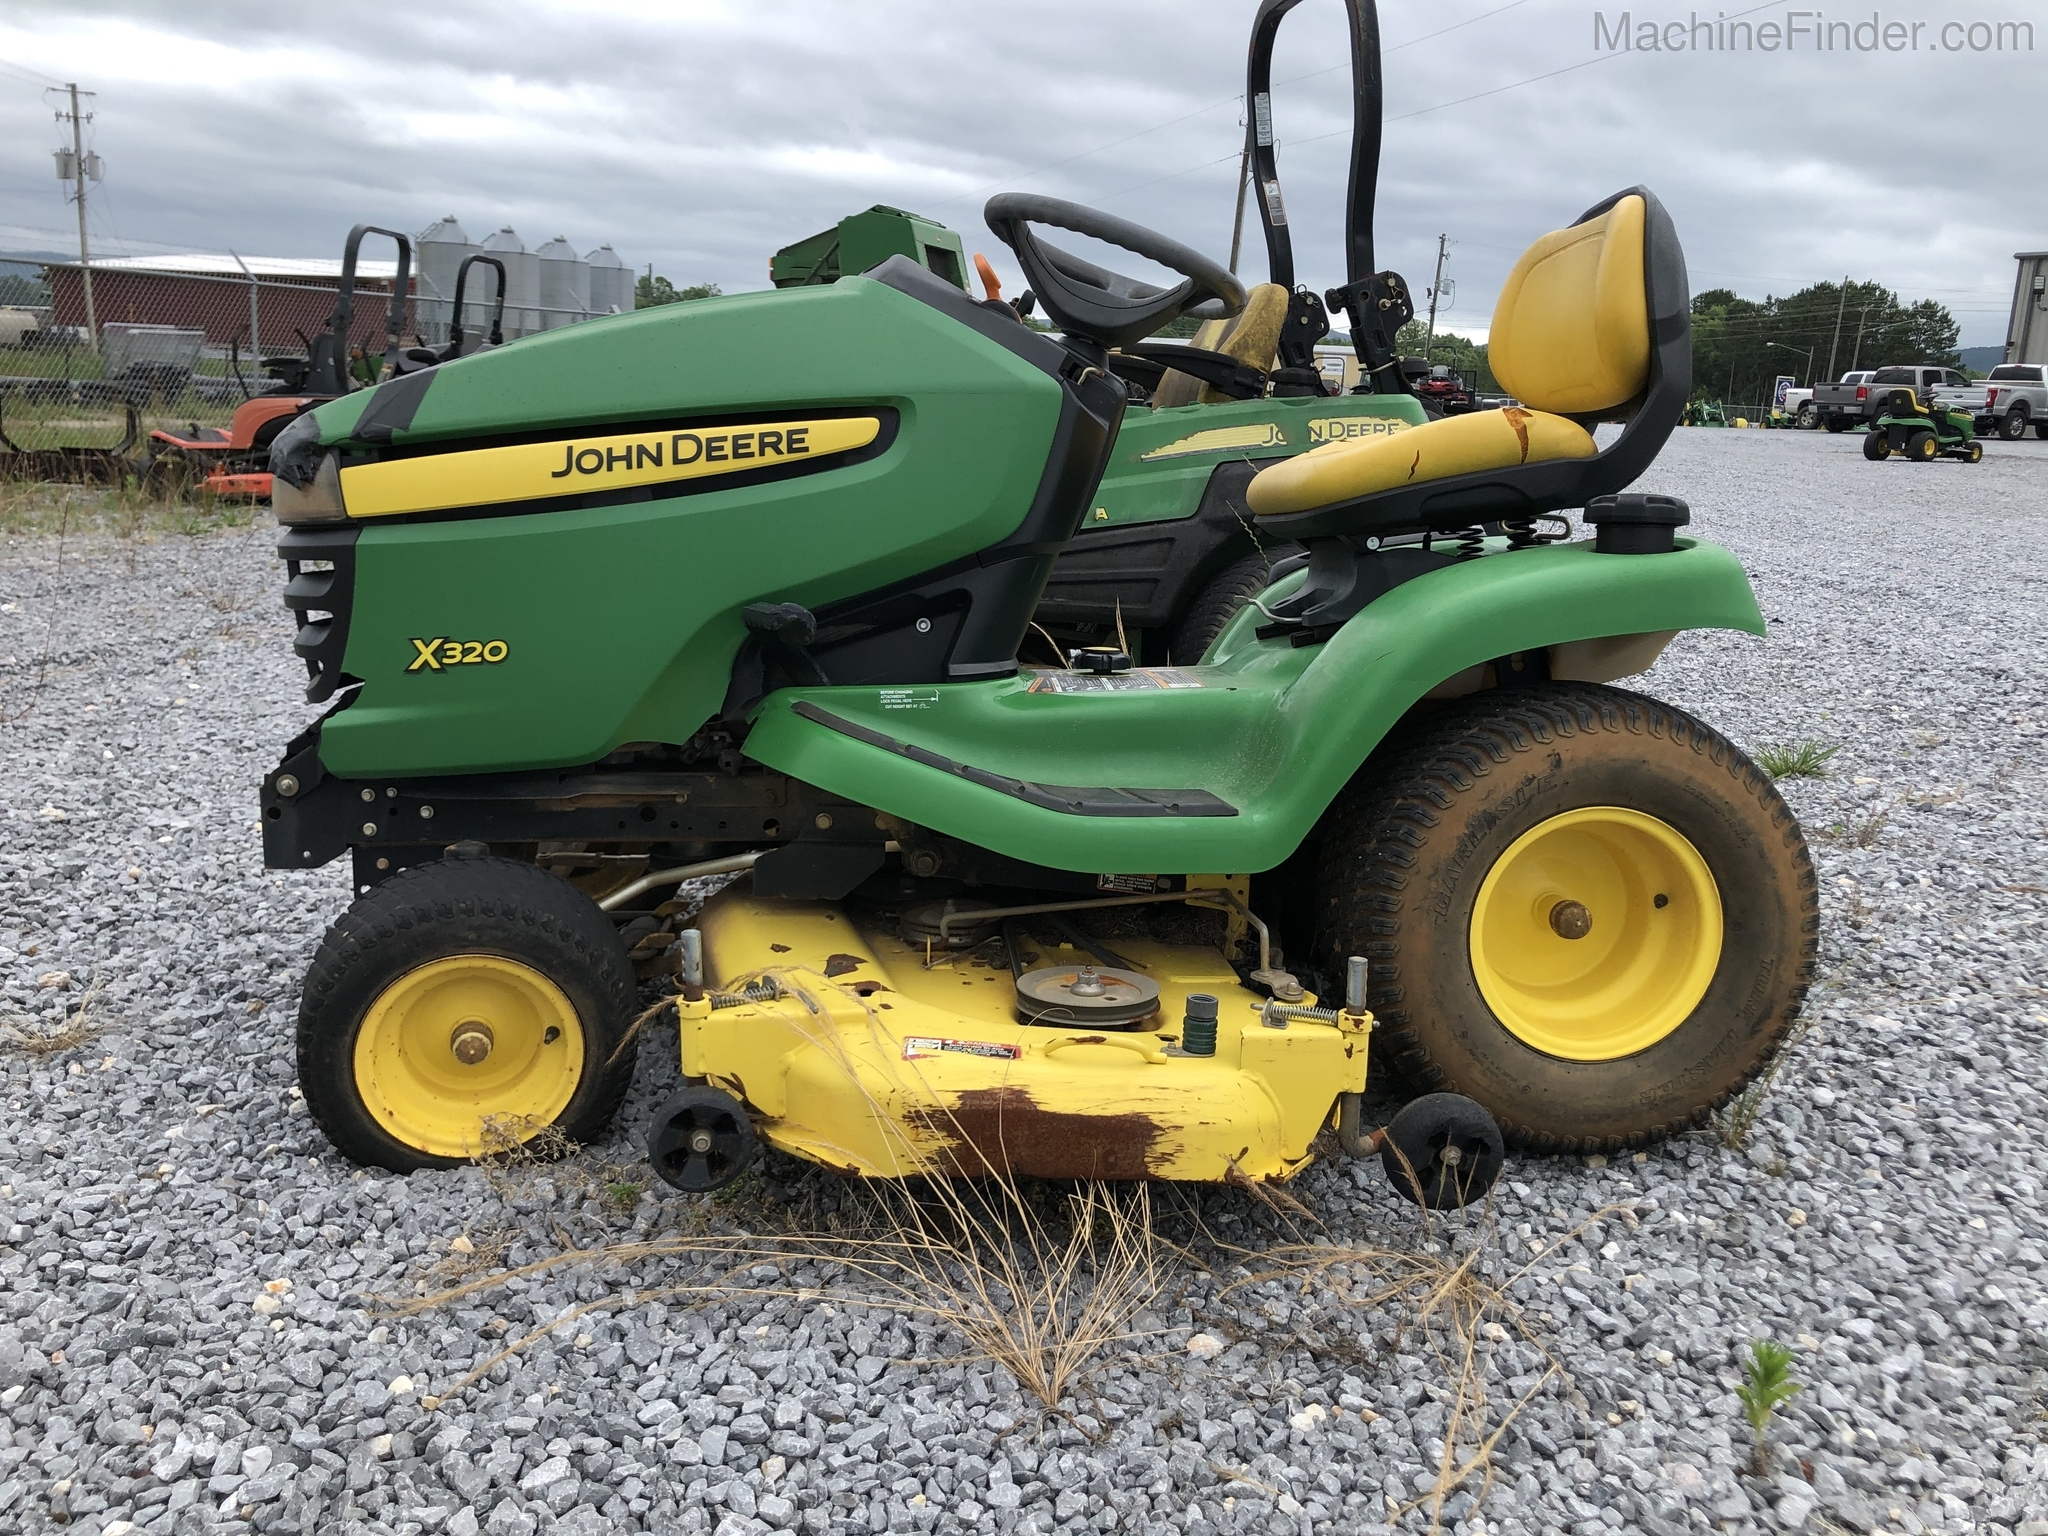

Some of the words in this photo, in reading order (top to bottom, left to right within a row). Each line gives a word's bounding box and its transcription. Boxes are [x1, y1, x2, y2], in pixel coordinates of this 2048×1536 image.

[551, 441, 663, 478] JOHN
[672, 427, 810, 466] DEERE
[406, 637, 508, 672] X320
